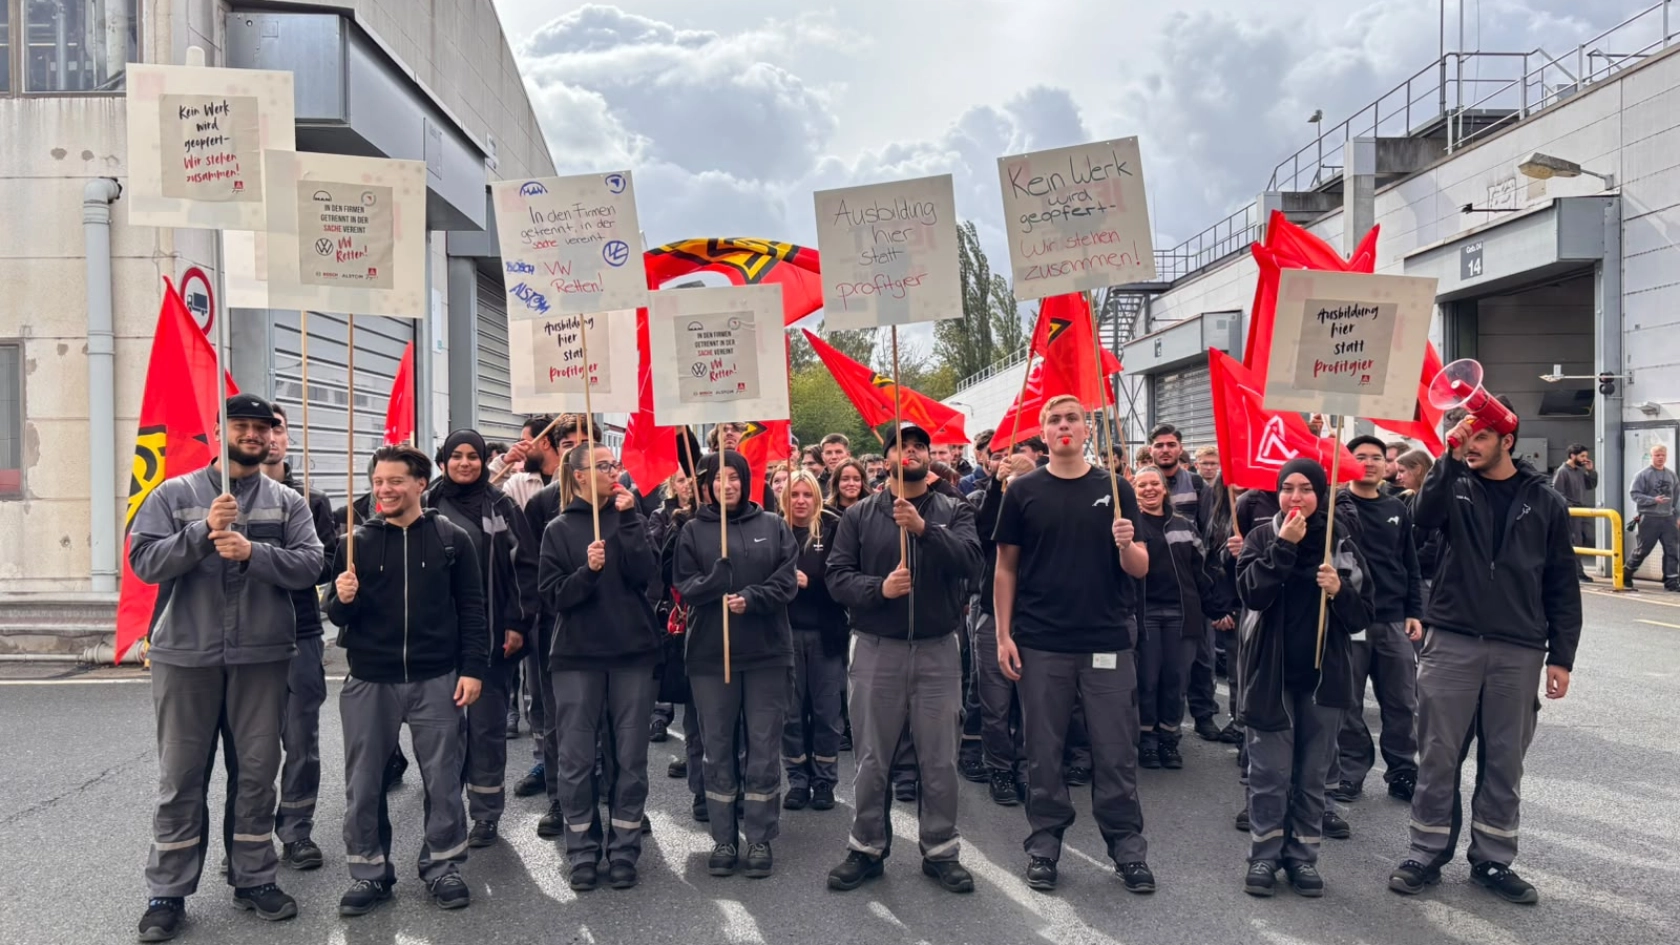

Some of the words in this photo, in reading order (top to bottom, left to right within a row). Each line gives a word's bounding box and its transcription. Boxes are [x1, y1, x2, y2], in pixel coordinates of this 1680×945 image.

[179, 104, 200, 120] Kein
[203, 100, 230, 117] Werk
[196, 117, 219, 132] wird
[184, 154, 202, 170] Wir
[206, 152, 237, 166] stehen
[186, 163, 240, 183] zusammen!
[1007, 165, 1066, 199] Kein
[1069, 150, 1133, 184] Werk
[1047, 188, 1093, 206] wird
[324, 204, 331, 212] IN
[331, 204, 343, 213] DEN
[343, 205, 365, 213] FIRMEN
[529, 205, 544, 224] In
[547, 209, 572, 223] den
[572, 202, 616, 217] Firmen
[833, 198, 938, 227] Ausbildung
[320, 214, 349, 222] GETRENNT
[350, 216, 357, 224] IN
[357, 216, 369, 224] DER
[580, 221, 592, 231] in
[597, 219, 615, 229] der
[323, 224, 342, 233] SACHE
[342, 225, 366, 234] VEREINT
[872, 225, 914, 244] hier
[565, 232, 606, 245] vereint
[1020, 239, 1057, 259] Wir
[1065, 229, 1121, 250] stehen
[336, 245, 368, 263] Retten!
[1024, 240, 1141, 281] zusammen!
[505, 260, 535, 275] BOSCH
[543, 260, 572, 276] VW
[1468, 257, 1481, 277] 14
[550, 272, 604, 294] Retten!
[1317, 303, 1379, 325] Ausbildung
[1330, 322, 1356, 338] hier
[557, 333, 578, 348] hier
[1333, 340, 1364, 355] statt
[549, 363, 598, 383] profitger
[1313, 358, 1375, 378] profitgier
